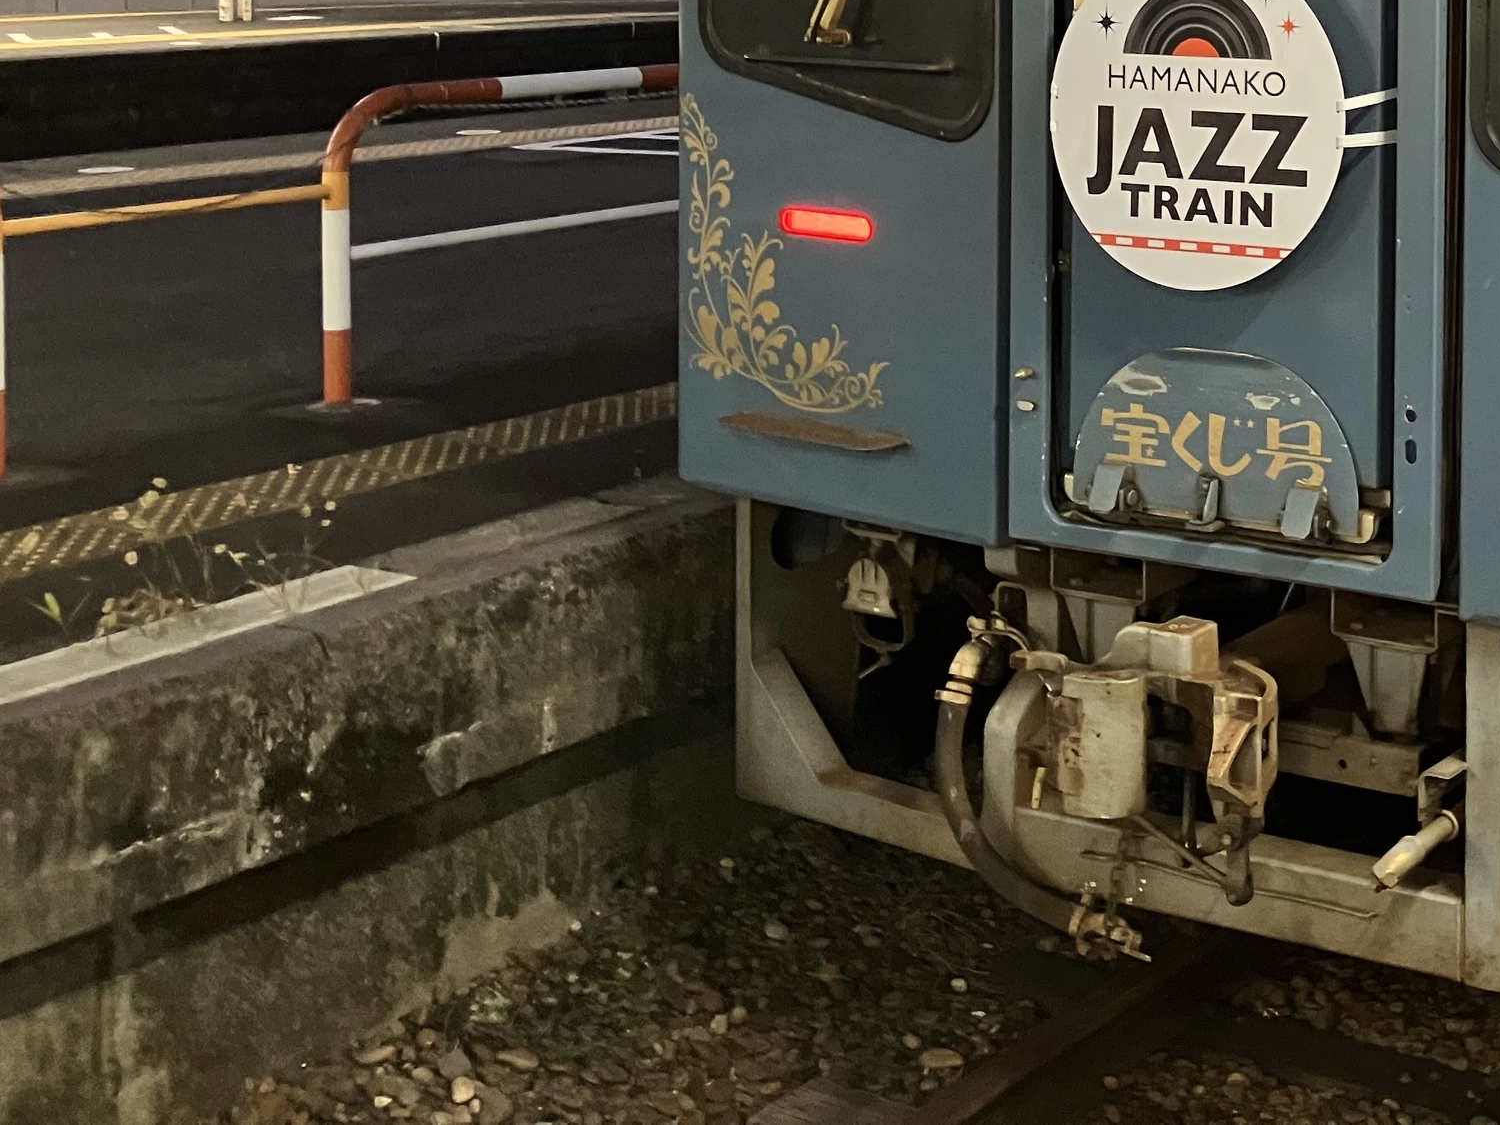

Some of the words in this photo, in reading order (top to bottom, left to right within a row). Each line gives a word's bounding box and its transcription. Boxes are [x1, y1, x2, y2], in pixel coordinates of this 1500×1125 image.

[1108, 63, 1286, 97] HAMANAKO
[1086, 105, 1309, 195] JAZZ
[1120, 182, 1274, 228] TRAIN
[1101, 403, 1333, 487] 宝くじ号
